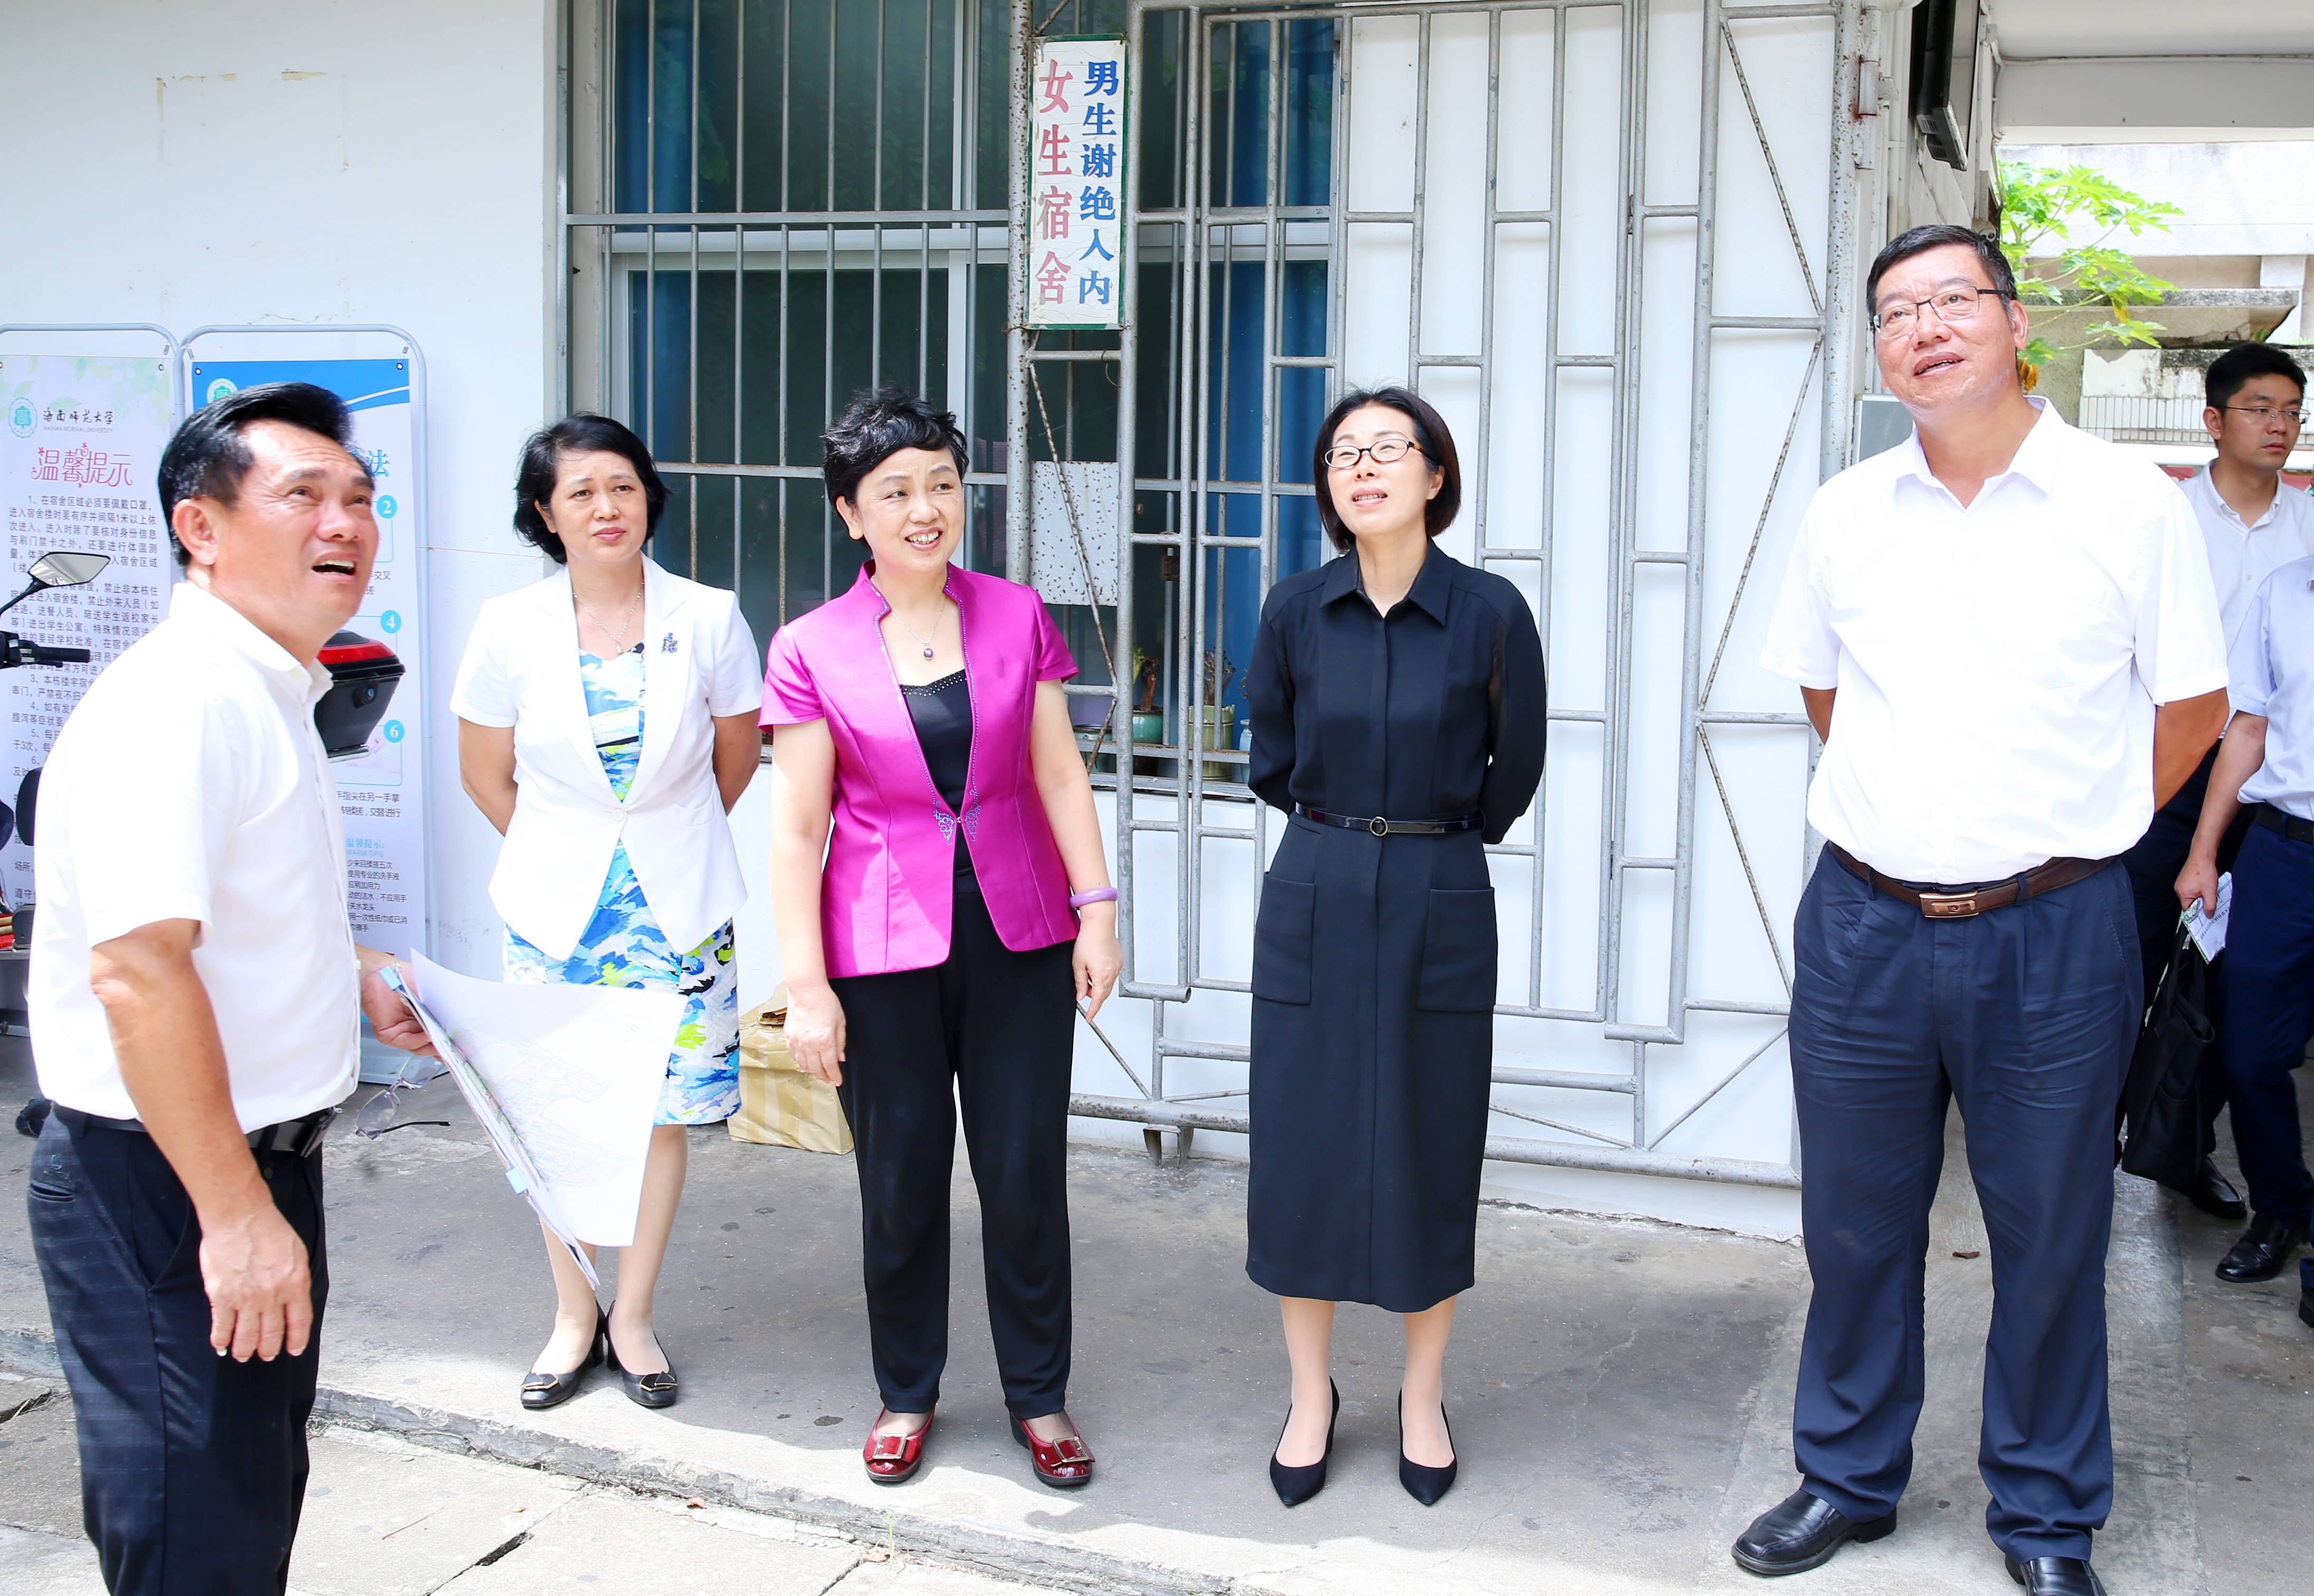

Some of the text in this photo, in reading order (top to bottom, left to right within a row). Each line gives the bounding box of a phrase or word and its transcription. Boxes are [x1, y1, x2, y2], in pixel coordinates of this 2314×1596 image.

[1036, 59, 1074, 306] 女生宿舍
[43, 407, 113, 424] 海南师范大学
[31, 443, 132, 487] 温馨提示
[383, 500, 391, 514] 2
[109, 555, 158, 568] 入宿舍区域
[386, 615, 395, 628] 4
[390, 725, 399, 738] 6
[346, 859, 393, 869] 少来回揉搓五次
[15, 888, 35, 899] 遵守
[348, 911, 407, 924] 用一次性纸巾或已消
